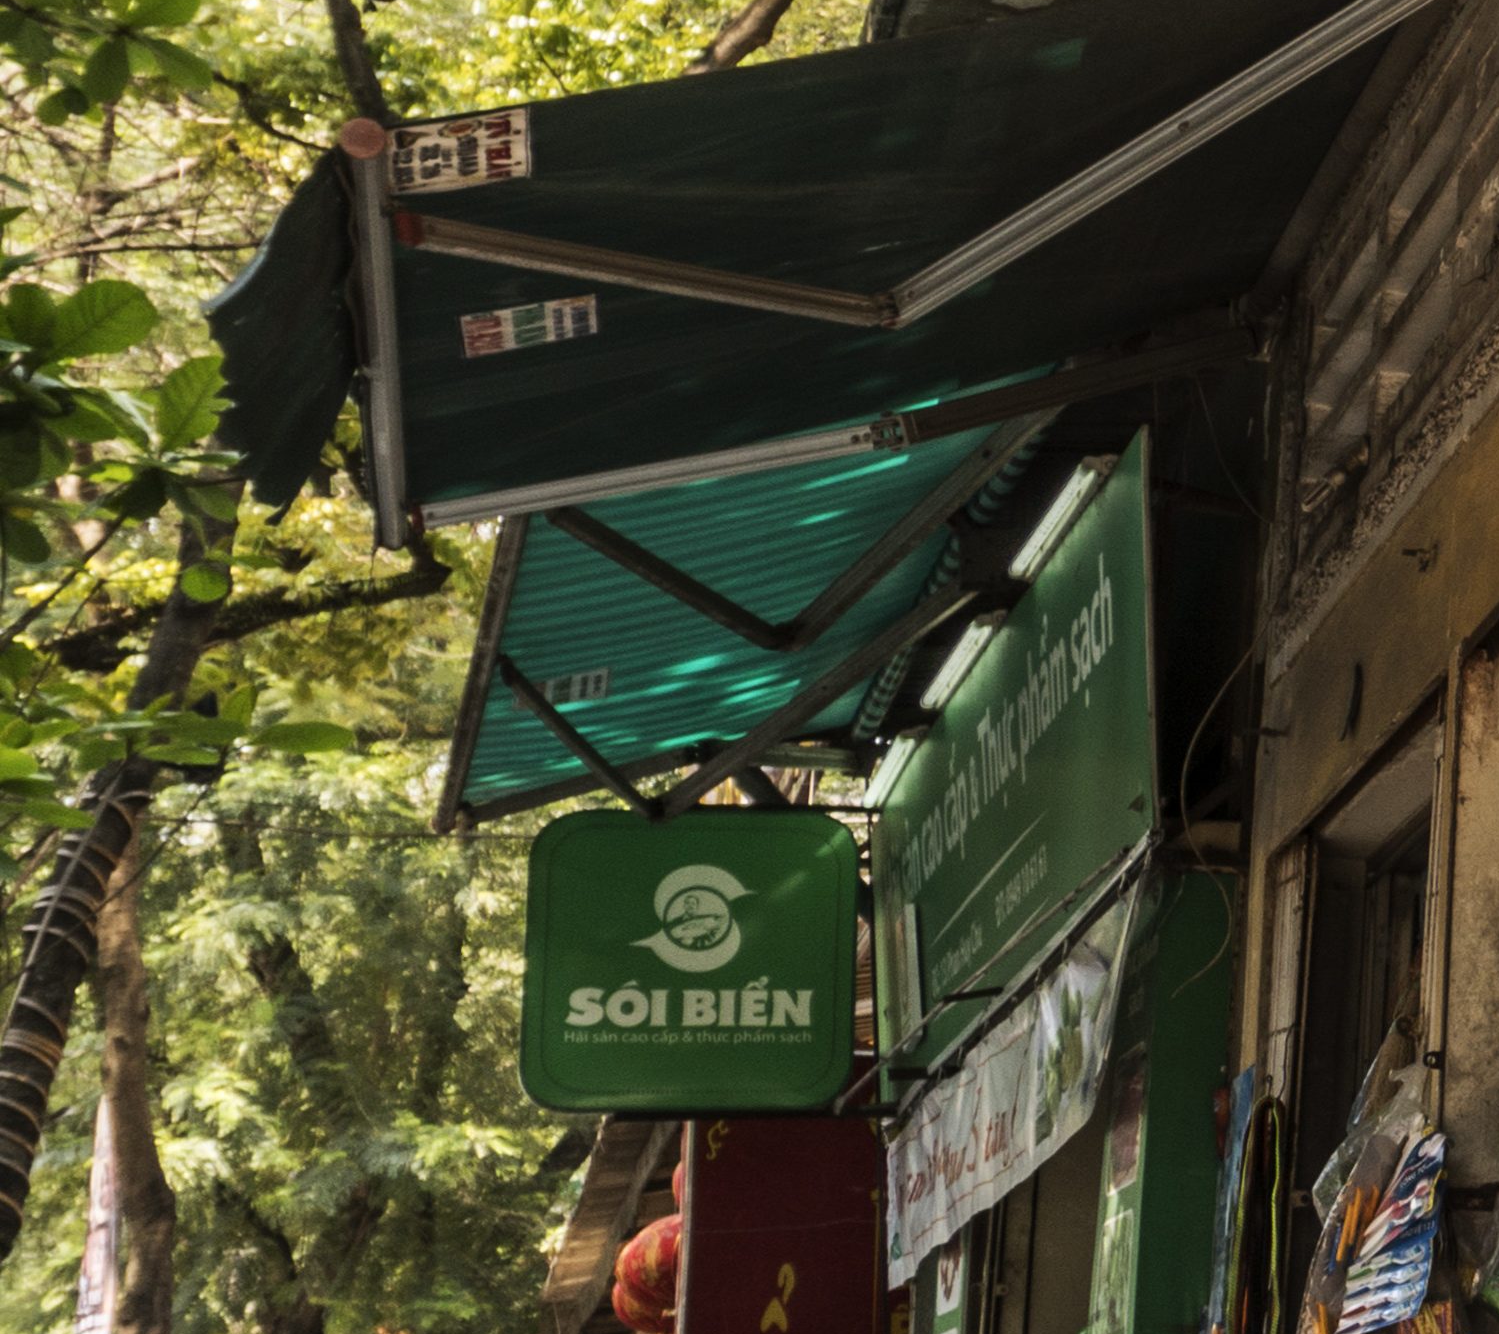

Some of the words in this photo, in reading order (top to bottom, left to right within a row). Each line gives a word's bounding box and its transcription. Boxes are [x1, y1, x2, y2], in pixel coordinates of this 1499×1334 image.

[565, 979, 670, 1028] SÓI
[682, 975, 813, 1028] BIỂN
[621, 1032, 648, 1044] cao
[682, 1031, 694, 1044] &
